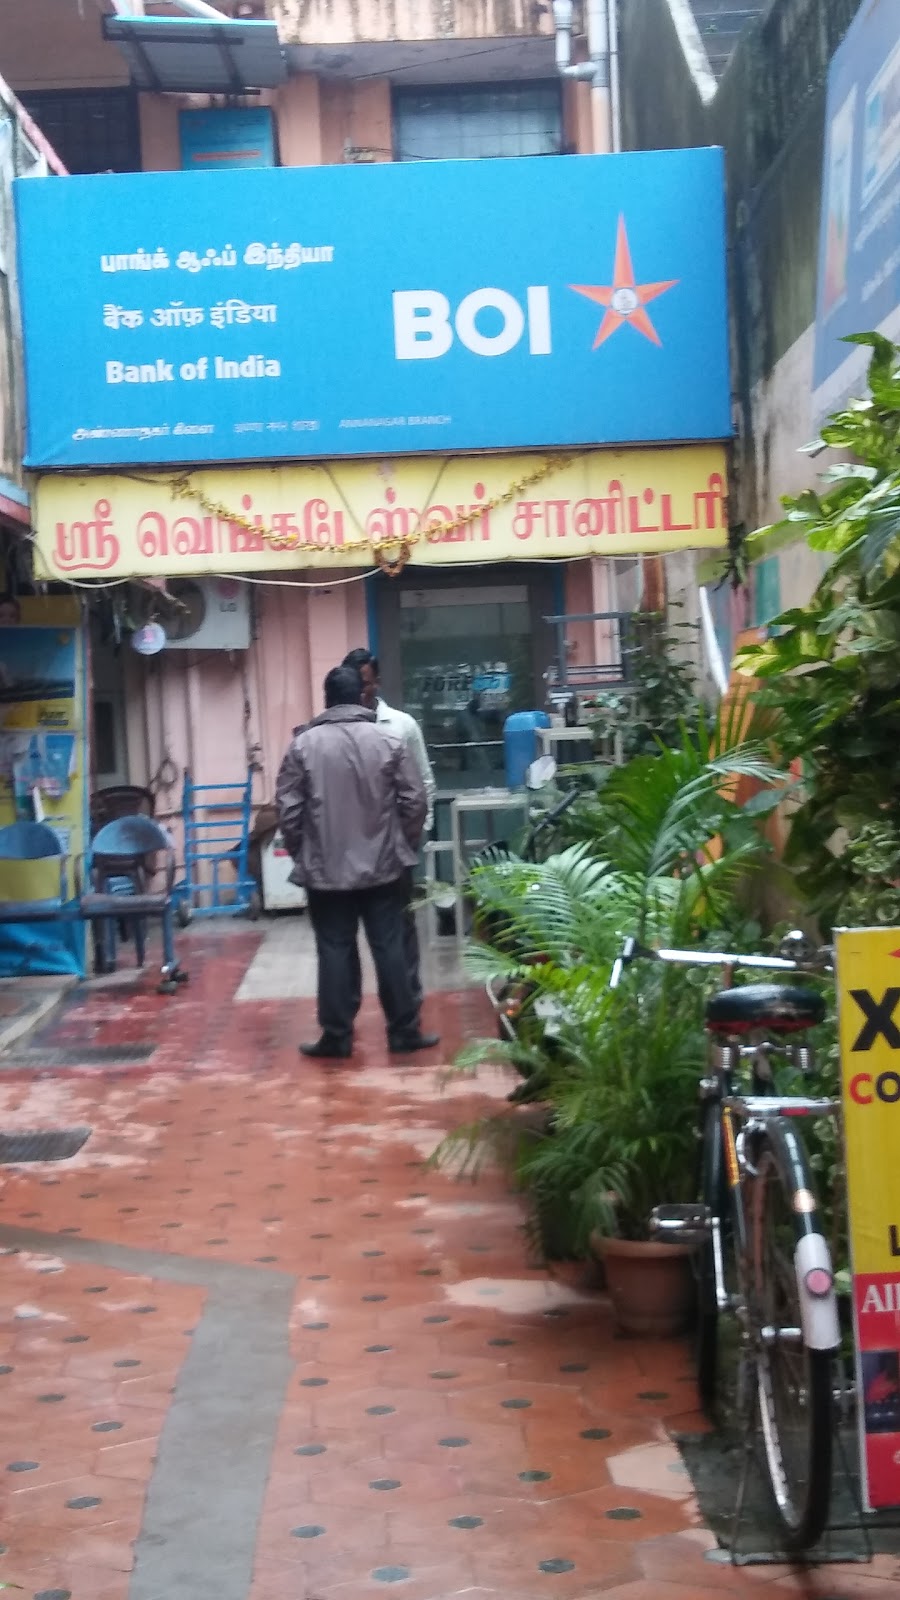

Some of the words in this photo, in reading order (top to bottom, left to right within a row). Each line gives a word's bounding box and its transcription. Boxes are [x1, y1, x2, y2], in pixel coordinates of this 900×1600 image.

[101, 247, 170, 273] பாங்க்
[176, 243, 238, 273] ஆஃப்
[243, 242, 335, 271] இந்தியா
[102, 303, 145, 330] बैंक
[209, 298, 278, 329] इंडिया
[392, 285, 552, 360] BOI
[105, 358, 175, 384] Bank
[179, 356, 209, 381] of
[214, 354, 281, 379] India
